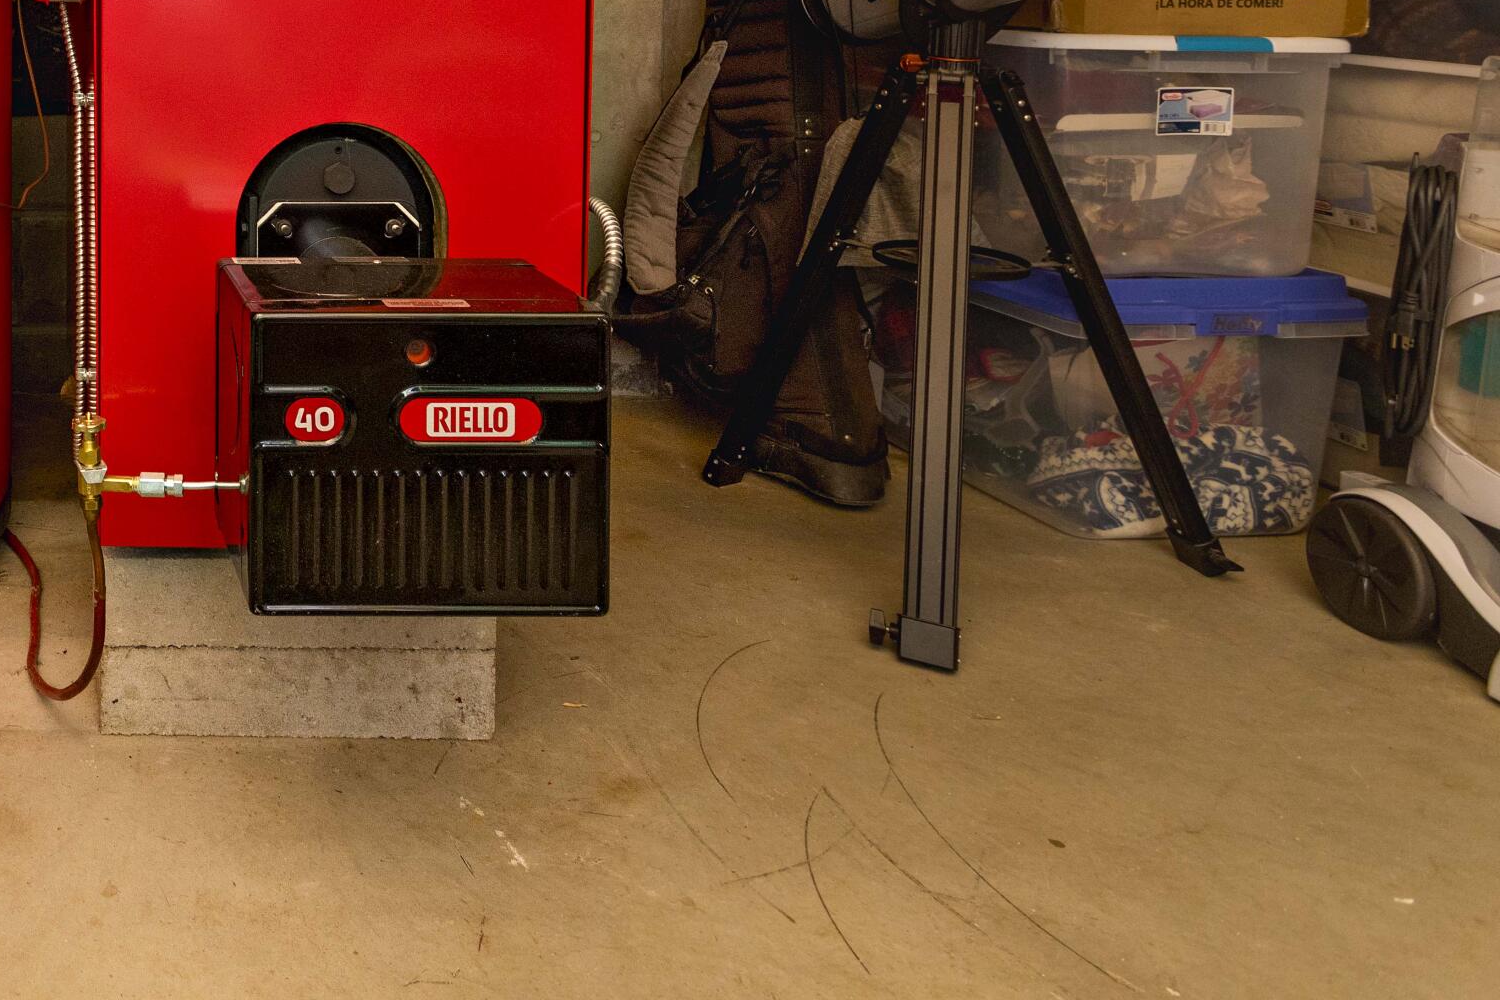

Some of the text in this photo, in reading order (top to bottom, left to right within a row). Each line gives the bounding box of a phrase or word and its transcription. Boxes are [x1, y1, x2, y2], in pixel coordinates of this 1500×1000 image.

[1178, 0, 1213, 8] HORA
[1217, 0, 1232, 8] DE
[1236, 0, 1283, 8] COMER!
[294, 406, 509, 433] 40 RIELLO
